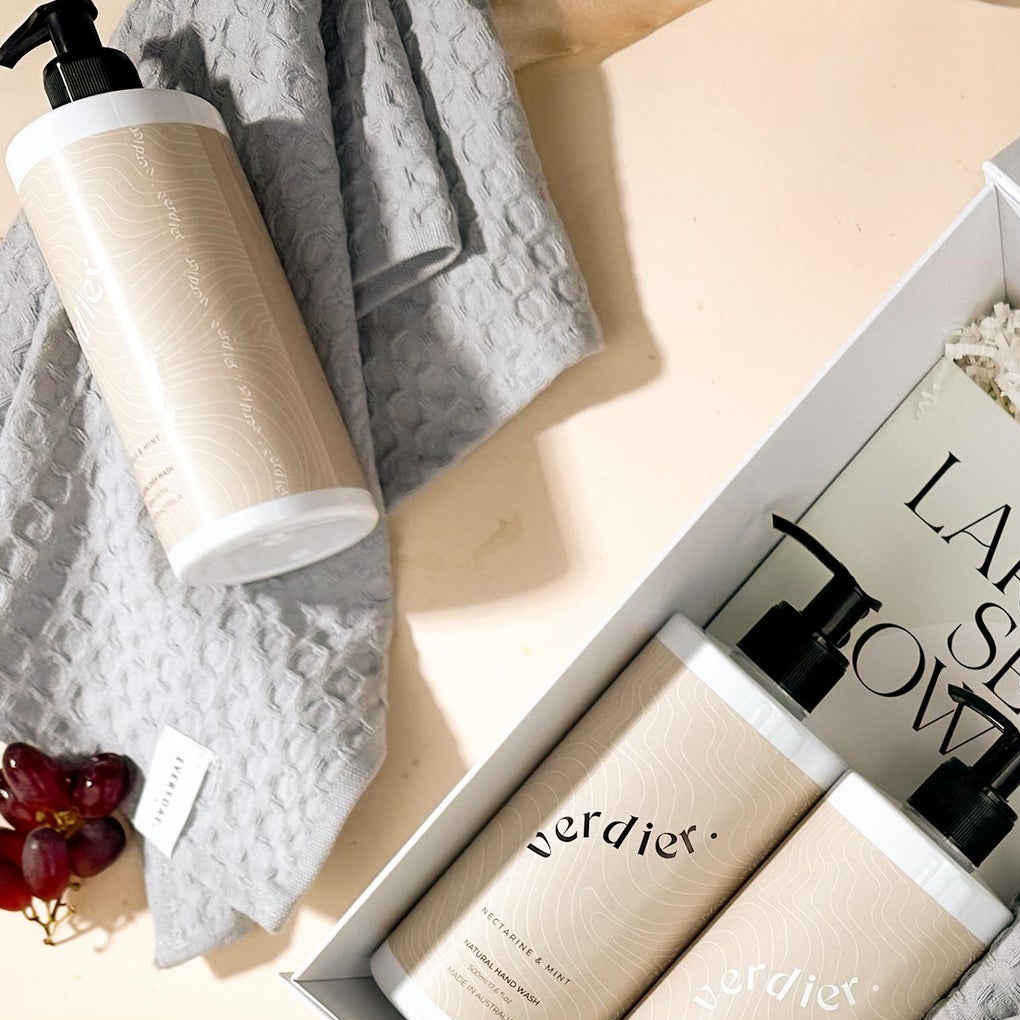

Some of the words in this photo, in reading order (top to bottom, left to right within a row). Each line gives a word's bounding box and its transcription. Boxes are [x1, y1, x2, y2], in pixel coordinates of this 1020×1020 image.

[852, 623, 1005, 756] OW
[445, 965, 466, 988] MADE
[465, 984, 476, 996] IN
[463, 939, 494, 970] NATURAL
[494, 967, 517, 988] HAND
[517, 986, 540, 1006] WASH
[481, 906, 534, 957] NECTARINE
[535, 956, 543, 965] &
[544, 964, 573, 985] MINT
